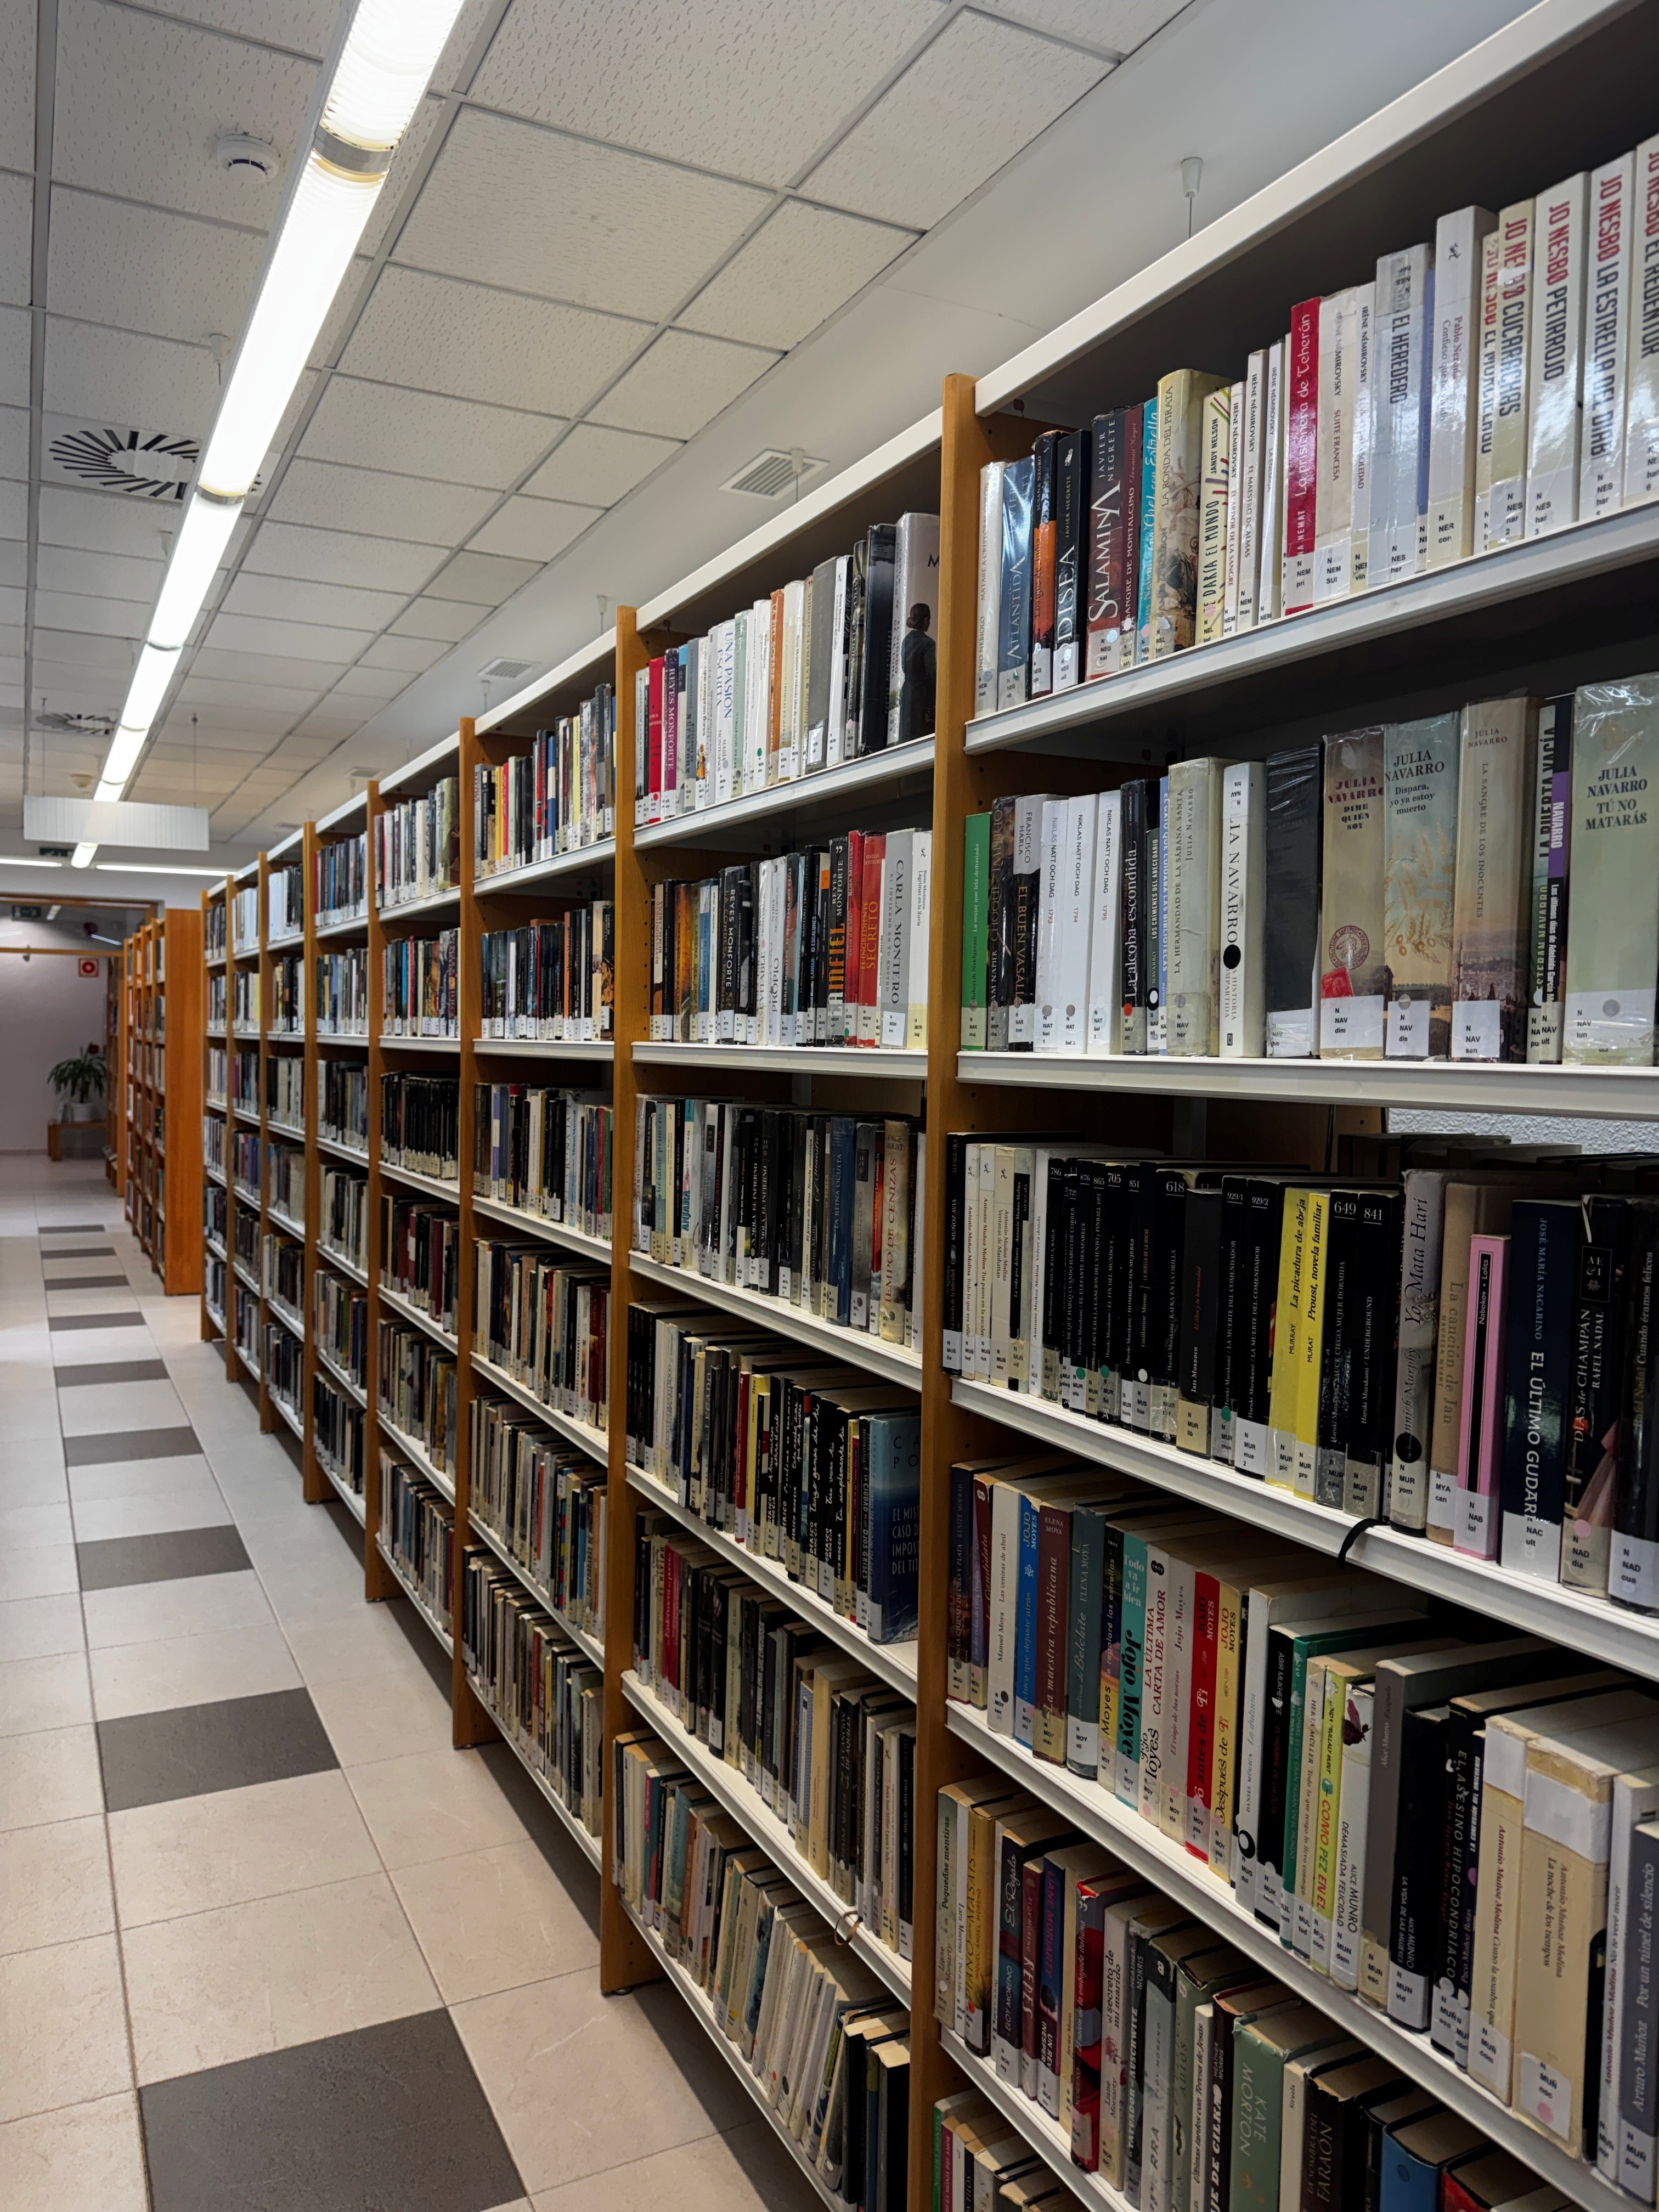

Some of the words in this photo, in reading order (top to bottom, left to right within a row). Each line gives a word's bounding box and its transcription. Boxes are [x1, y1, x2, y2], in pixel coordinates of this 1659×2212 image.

[1600, 174, 1622, 199] JO
[1505, 218, 1527, 241] JO
[1549, 201, 1570, 225] JO
[1598, 199, 1622, 262] NESBØ
[1546, 224, 1569, 286] NESBØ
[1597, 262, 1619, 289] LA
[1392, 314, 1410, 332] EL
[1441, 320, 1451, 359] Confieso
[1453, 315, 1463, 342] Pablo
[1544, 285, 1567, 381] PETIRROJO
[1594, 287, 1618, 375] ESTRELLA
[1297, 314, 1310, 377] Teherán
[1499, 301, 1524, 416] CUCARACHAS
[1165, 386, 1173, 425] PIRATA
[1299, 381, 1308, 398] de
[1593, 375, 1615, 410] DEL
[1164, 426, 1172, 447] DEL
[1249, 398, 1257, 453] NÉMIROVSKY
[1298, 402, 1309, 476] prisionera
[1162, 448, 1171, 489] RONDA
[1161, 490, 1170, 507] LA
[1295, 475, 1307, 497] La
[1205, 500, 1219, 541] MUNDO
[1536, 501, 1551, 511] NES
[1297, 511, 1306, 541] NEMAT
[1438, 523, 1454, 532] NER
[1088, 480, 1120, 622] SALAMINA
[1206, 544, 1217, 556] EL
[1127, 560, 1133, 575] DE
[1203, 560, 1217, 597] DARÍA
[1327, 566, 1341, 574] NEM
[724, 632, 735, 663] UNA
[667, 707, 675, 770] MONFORTE
[1385, 761, 1445, 783] NAVARRO
[1393, 749, 1432, 767] JULIA
[1481, 763, 1489, 776] LA
[1598, 765, 1638, 782] JULIA
[1336, 776, 1376, 791] JULIA
[1390, 799, 1400, 808] yo
[1401, 796, 1410, 806] ya
[1412, 792, 1435, 803] estoy
[1395, 783, 1429, 795] Dispara,
[1479, 779, 1488, 818] SANGRE
[1587, 778, 1648, 798] NAVARRO
[1176, 789, 1184, 823] SANTA
[1186, 788, 1194, 831] NAVARRO
[1341, 811, 1370, 823] QUIÉN
[1344, 803, 1369, 812] DIME
[1396, 804, 1426, 815] muerto
[1585, 810, 1647, 830] MATARÁS
[1596, 799, 1615, 814] TÚ
[1618, 798, 1637, 812] NO
[1024, 812, 1032, 864] FRANCISCO
[1347, 822, 1363, 831] SOY
[1480, 822, 1487, 834] DE
[1550, 802, 1565, 848] NAVARRO
[1185, 836, 1194, 861] JULIA
[895, 860, 905, 916] CARLA
[1125, 849, 1137, 923] escondida
[1227, 851, 1240, 944] NAVARRO
[1476, 860, 1485, 918] INOCENTES
[1550, 884, 1559, 895] Los
[1550, 896, 1559, 919] últimos
[866, 900, 878, 970] SECRETO
[1017, 906, 1027, 944] BUEN
[891, 922, 903, 1005] MONTERO
[1125, 928, 1137, 974] alcoba
[1547, 945, 1557, 971] Adelaida
[888, 1158, 898, 1223] CENIZAS
[1108, 1172, 1121, 1184] 705
[1166, 1181, 1185, 1193] 618
[1312, 1201, 1322, 1245] familiar
[1334, 1201, 1357, 1215] 649
[1363, 1207, 1383, 1221] 841
[1410, 1197, 1428, 1243] Hari
[1538, 1217, 1549, 1244] JOSÉ
[1291, 1246, 1302, 1294] picadura
[1310, 1245, 1320, 1281] novela
[1405, 1248, 1425, 1294] Mata
[1537, 1246, 1548, 1282] MARÍA
[1290, 1296, 1299, 1310] La
[1307, 1284, 1318, 1321] Proust,
[1404, 1305, 1423, 1326] Yo,
[1479, 1290, 1487, 1325] Nabokov
[1534, 1284, 1545, 1340] NACARINO
[1363, 1296, 1373, 1360] UNDERGROUND
[1531, 1352, 1544, 1371] EL
[1577, 1308, 1591, 1388] CHAMPÁN
[1442, 1397, 1458, 1424] Jan
[1527, 1377, 1546, 1446] ÚLTIMO
[892, 1524, 911, 1539] CASO
[1045, 1516, 1064, 1527] ELENA
[1046, 1526, 1063, 1536] MOYA
[1045, 1557, 1059, 1639] republicana
[1124, 1592, 1142, 1608] bien
[1156, 1590, 1166, 1638] AMOR
[1220, 1607, 1229, 1650] JOJO
[1153, 1666, 1163, 1716] CARTA
[1319, 1799, 1331, 1846] COMO
[1317, 1847, 1329, 1874] PEZ
[1336, 1878, 1346, 1928] FELICIDAD
[1347, 1887, 1361, 1933] MUNRO
[1238, 2062, 1255, 2157] MORTON
[1254, 2096, 1268, 2143] KATE
